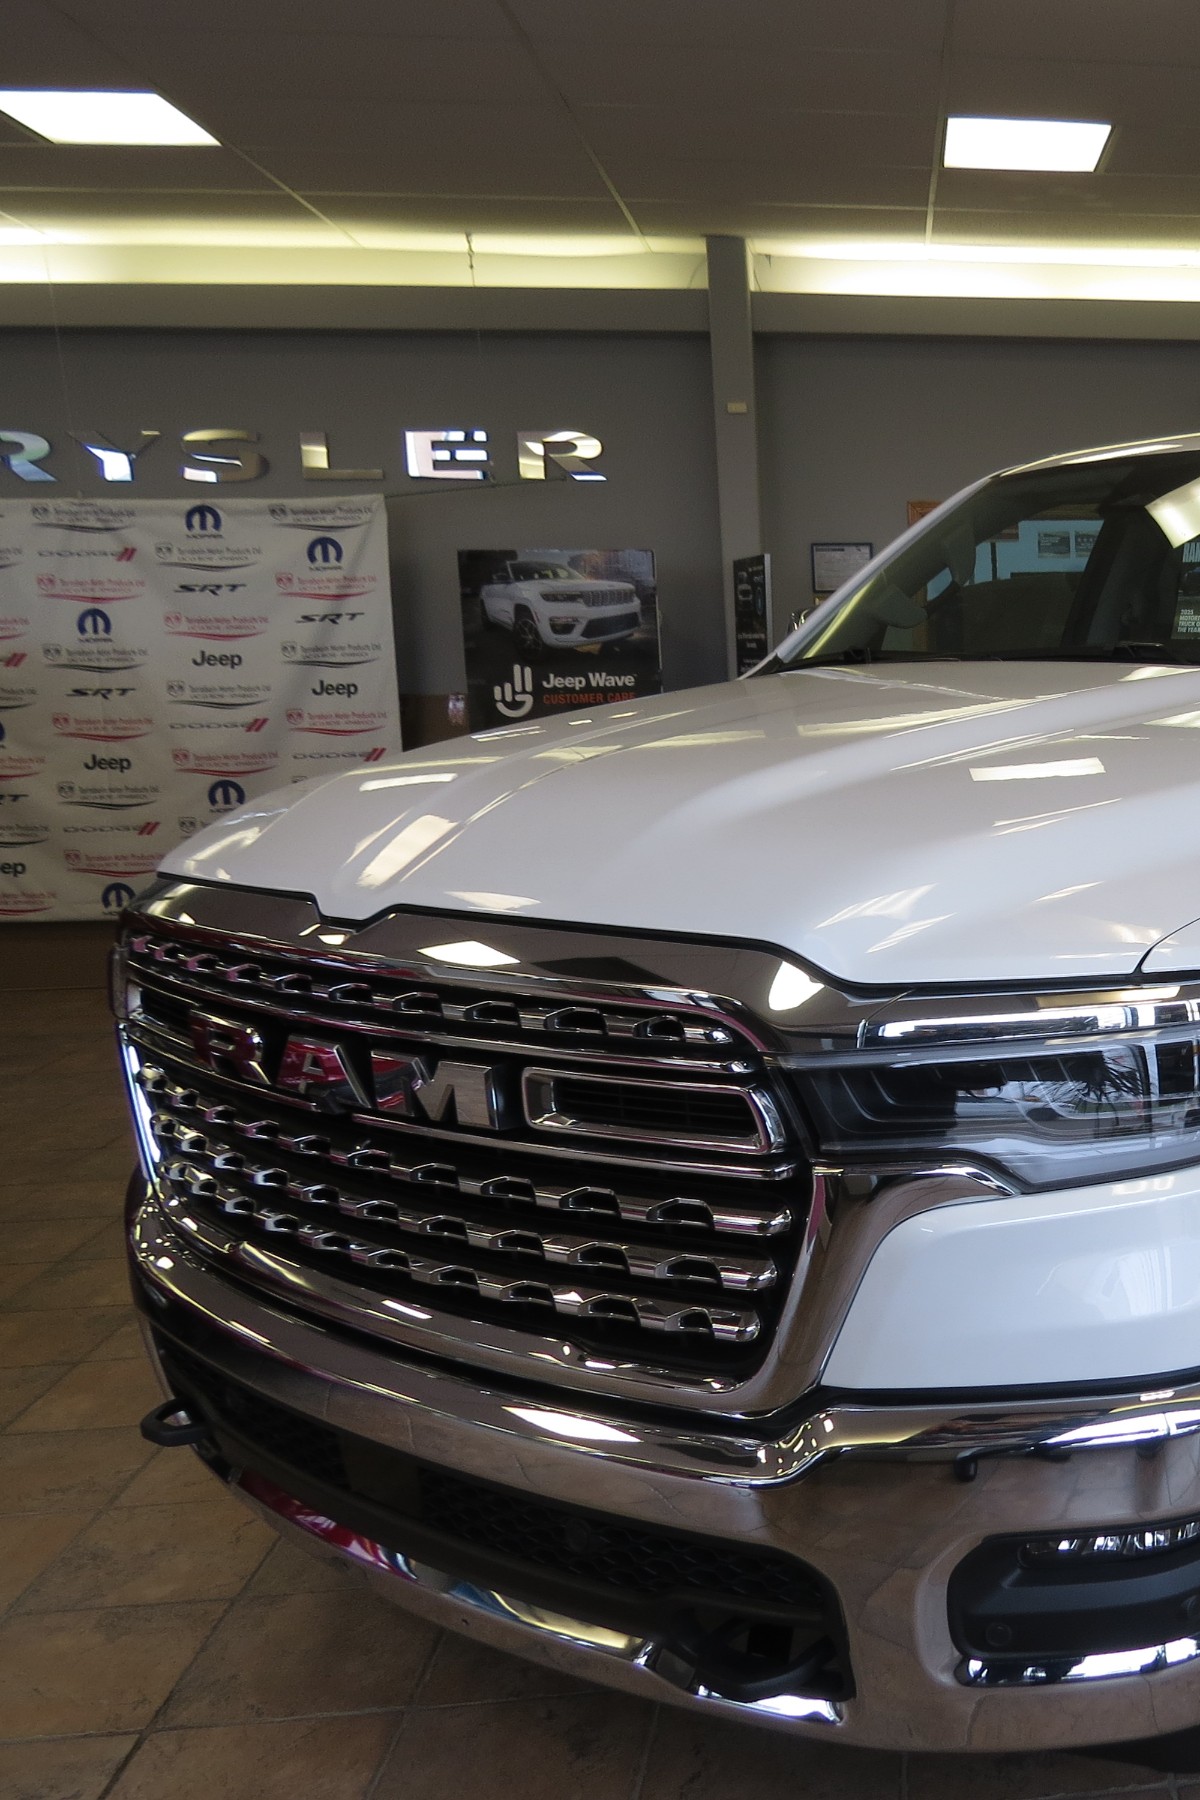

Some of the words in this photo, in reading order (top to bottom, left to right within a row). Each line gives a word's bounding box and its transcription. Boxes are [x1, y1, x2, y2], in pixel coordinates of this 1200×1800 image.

[174, 583, 248, 596] SRT
[295, 612, 366, 625] SRT
[191, 649, 243, 669] Jeep
[311, 679, 359, 698] Jeep
[541, 672, 587, 690] Jeep
[588, 671, 636, 687] Wave
[66, 688, 137, 700] SRT
[543, 692, 604, 705] CUSTOMER
[606, 691, 636, 703] CARE
[84, 753, 132, 773] Jeep
[188, 1006, 504, 1132] RAM
